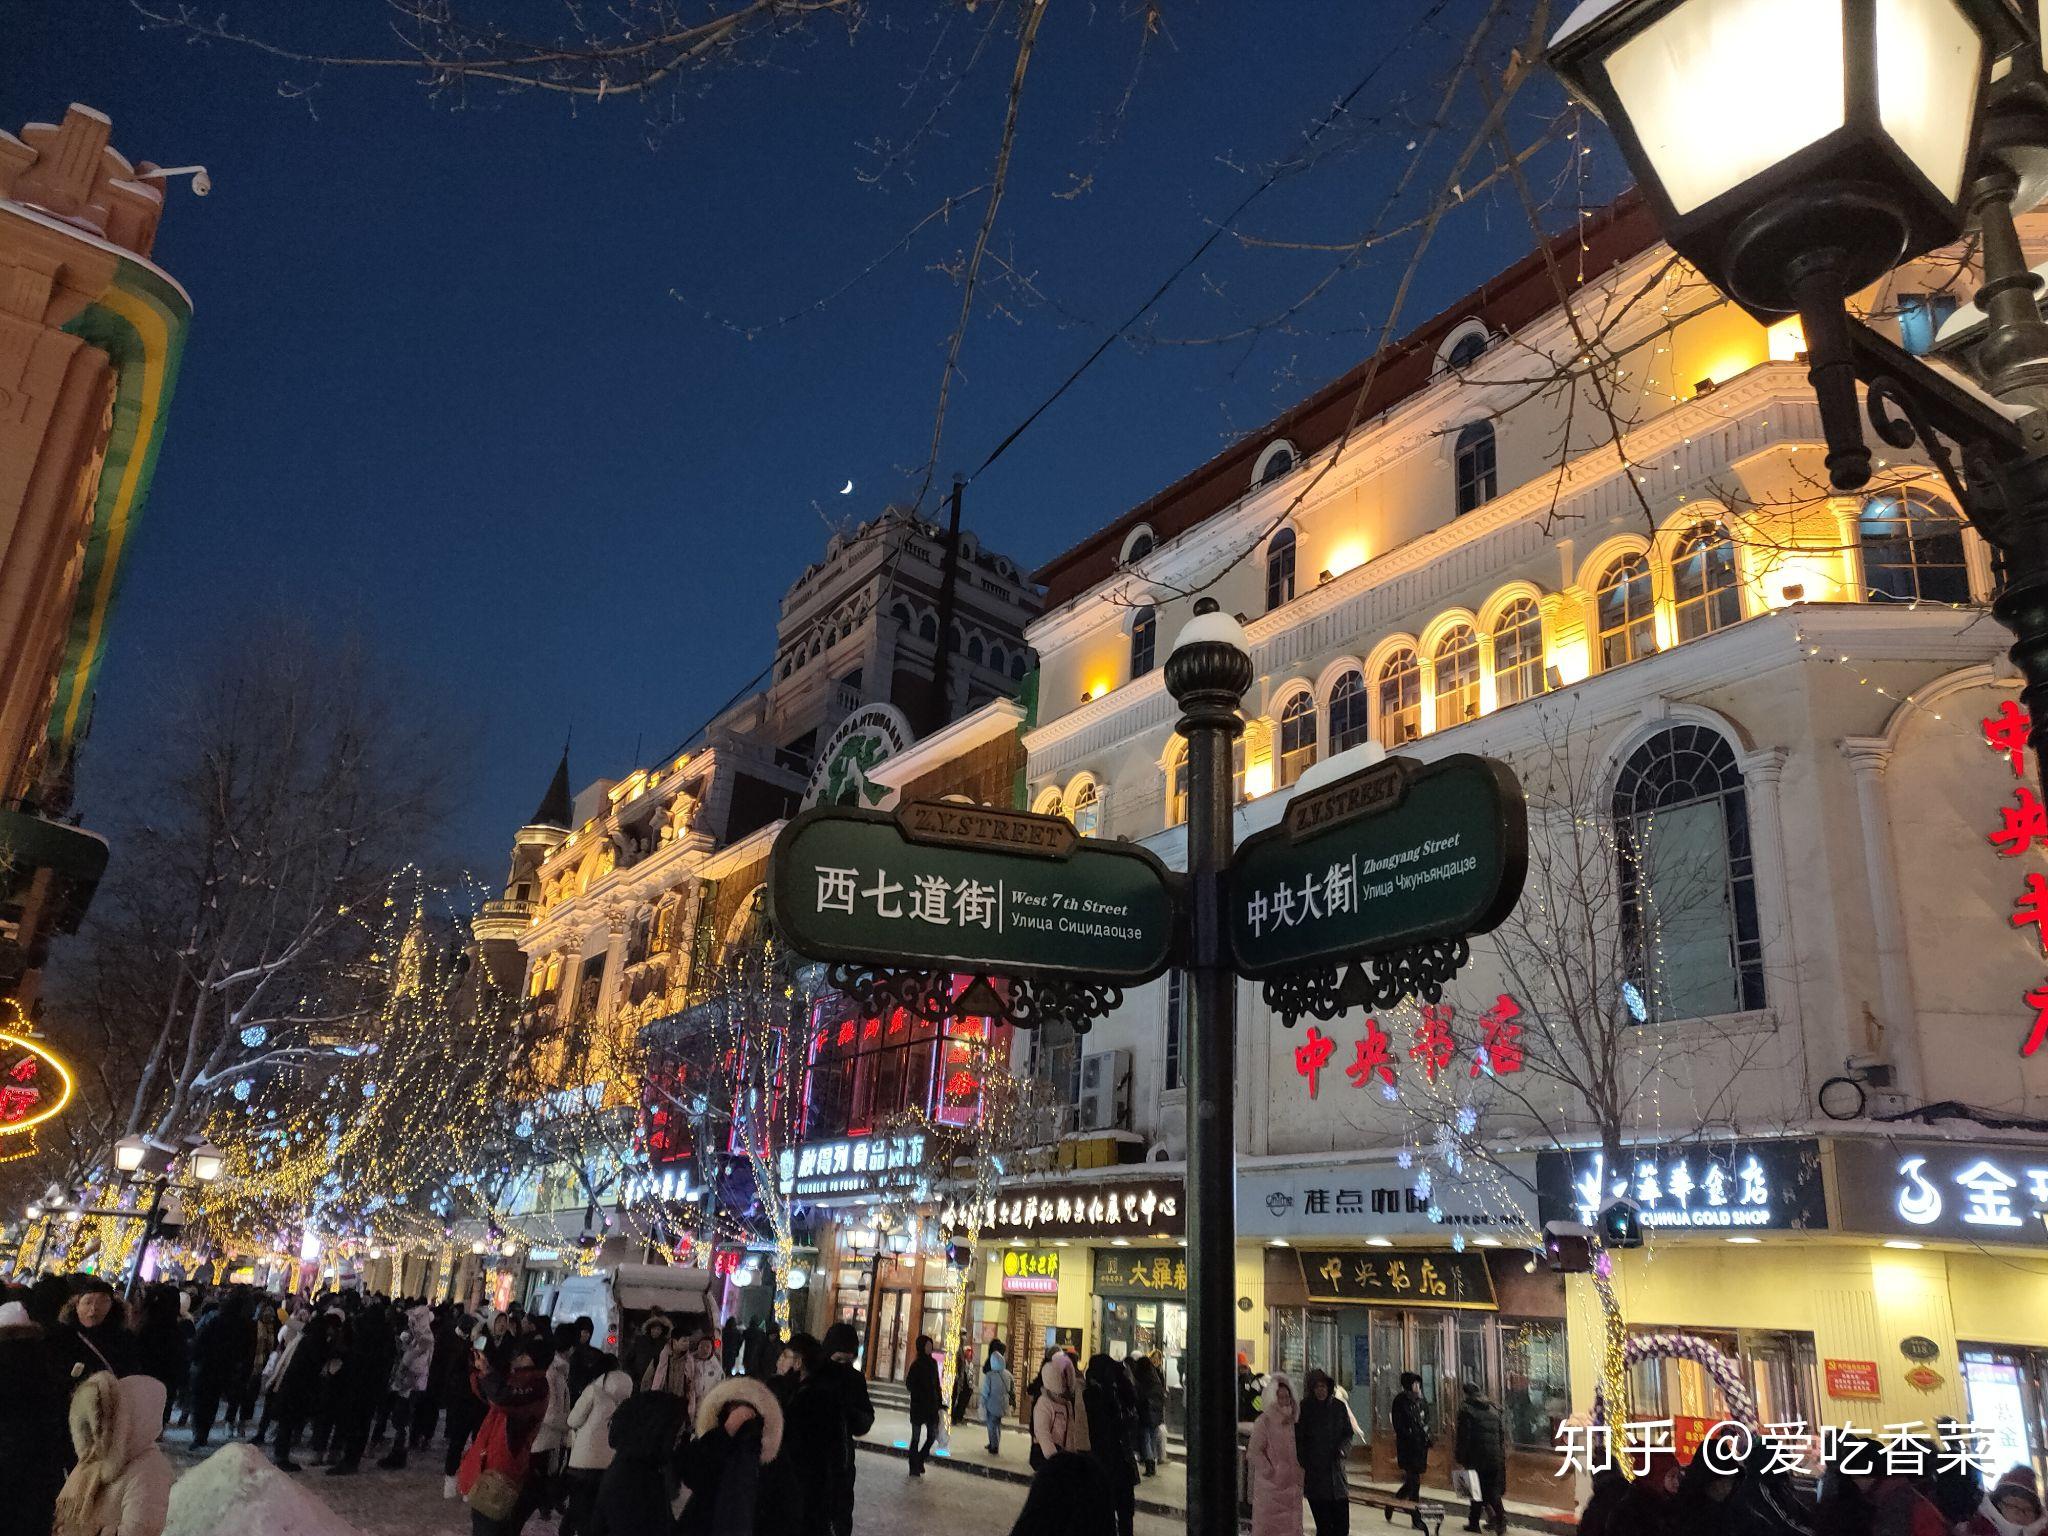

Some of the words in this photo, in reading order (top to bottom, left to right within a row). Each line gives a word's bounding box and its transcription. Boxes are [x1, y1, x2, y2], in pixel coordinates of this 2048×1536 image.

[1362, 844, 1421, 876] Zhongyang
[1422, 831, 1461, 856] Street
[815, 865, 997, 929] 西七道街
[1247, 862, 1353, 938] 中央大街
[1362, 877, 1394, 901] Улица
[1395, 855, 1477, 891] Чжунъяндацзе
[1011, 890, 1048, 908] West
[1051, 892, 1079, 911] 7th
[1082, 898, 1129, 917] Street
[1011, 911, 1054, 932] Улица
[1058, 916, 1143, 941] Сицидаоцзе
[1294, 993, 1526, 1100] 中央书店
[1638, 1211, 1691, 1226] CUIHUA
[1692, 1211, 1731, 1226] GOLD
[1732, 1209, 1771, 1225] SHOP
[1319, 1256, 1448, 1296] 中央书店
